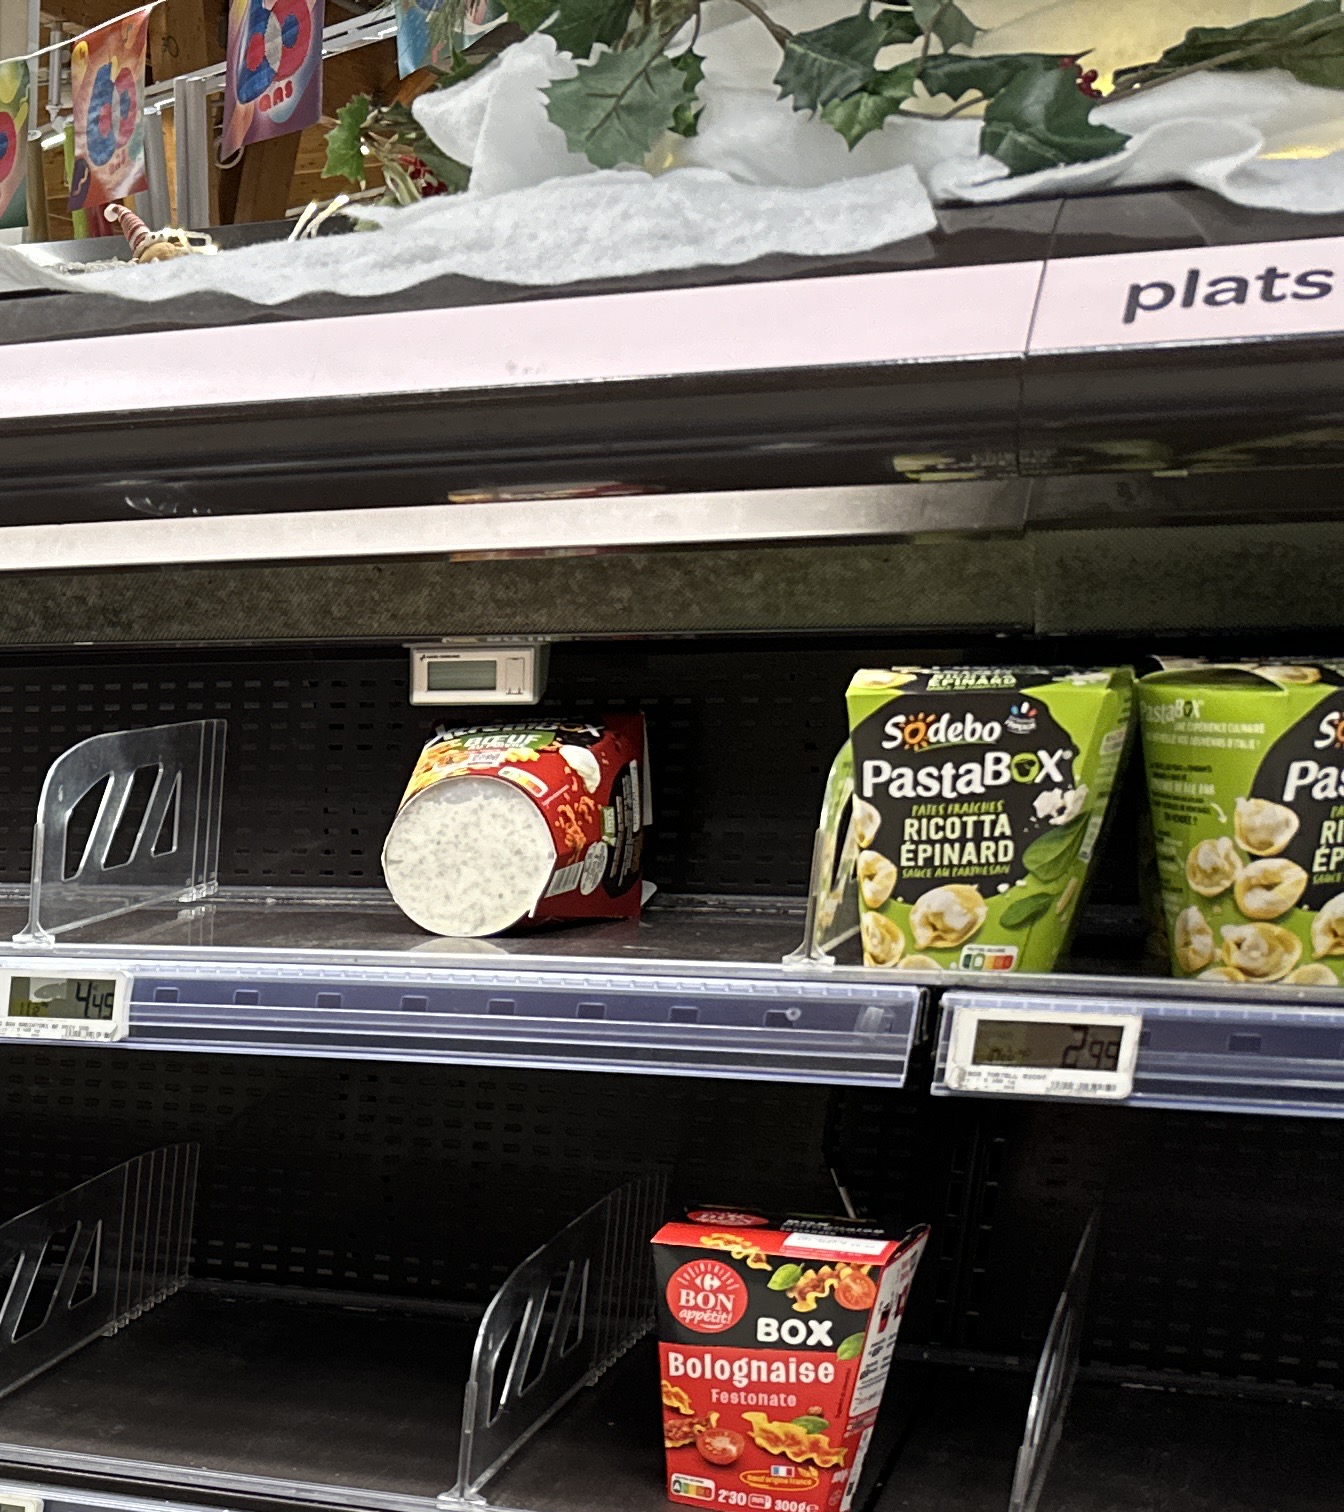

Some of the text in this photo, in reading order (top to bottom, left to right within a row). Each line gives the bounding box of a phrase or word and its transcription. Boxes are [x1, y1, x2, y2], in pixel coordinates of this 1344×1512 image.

[1121, 266, 1335, 325] plats
[881, 711, 1003, 751] Sodebo
[903, 813, 1013, 841] RICOTTA
[900, 839, 1014, 867] ÉPINARD
[679, 1288, 735, 1312] BON
[756, 1316, 834, 1348] BOX
[667, 1351, 836, 1388] Bolognaise
[711, 1388, 798, 1408] Festonate
